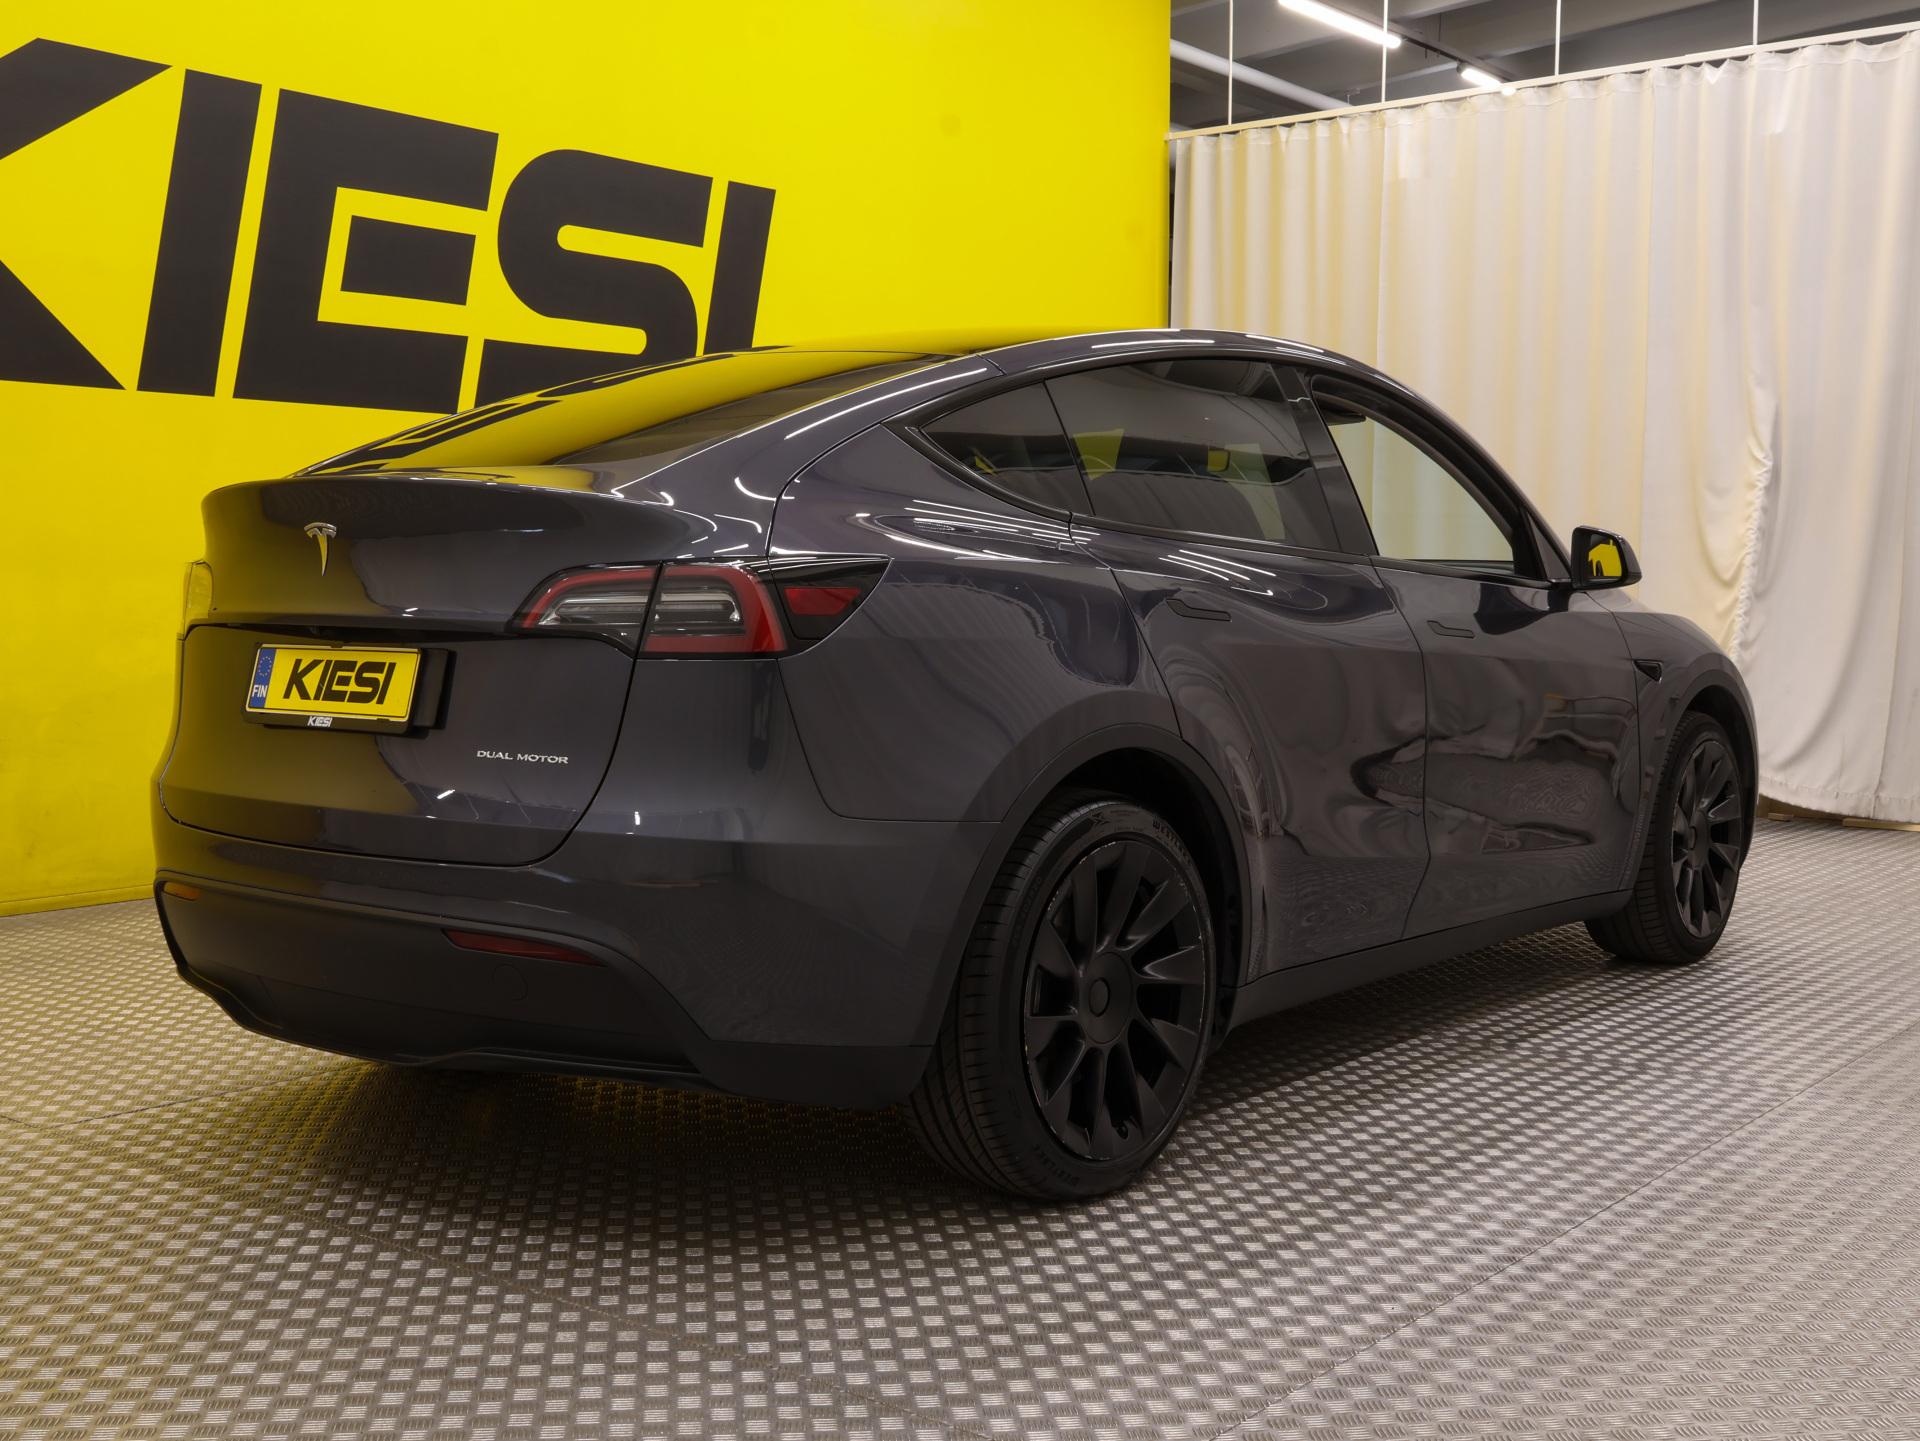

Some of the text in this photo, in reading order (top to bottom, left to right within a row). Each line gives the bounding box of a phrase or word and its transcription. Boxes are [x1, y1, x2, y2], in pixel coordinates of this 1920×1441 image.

[283, 658, 397, 705] KIESI
[252, 684, 268, 698] FIN
[307, 715, 333, 728] KIESI
[476, 750, 569, 764] DUAL MOTOR
